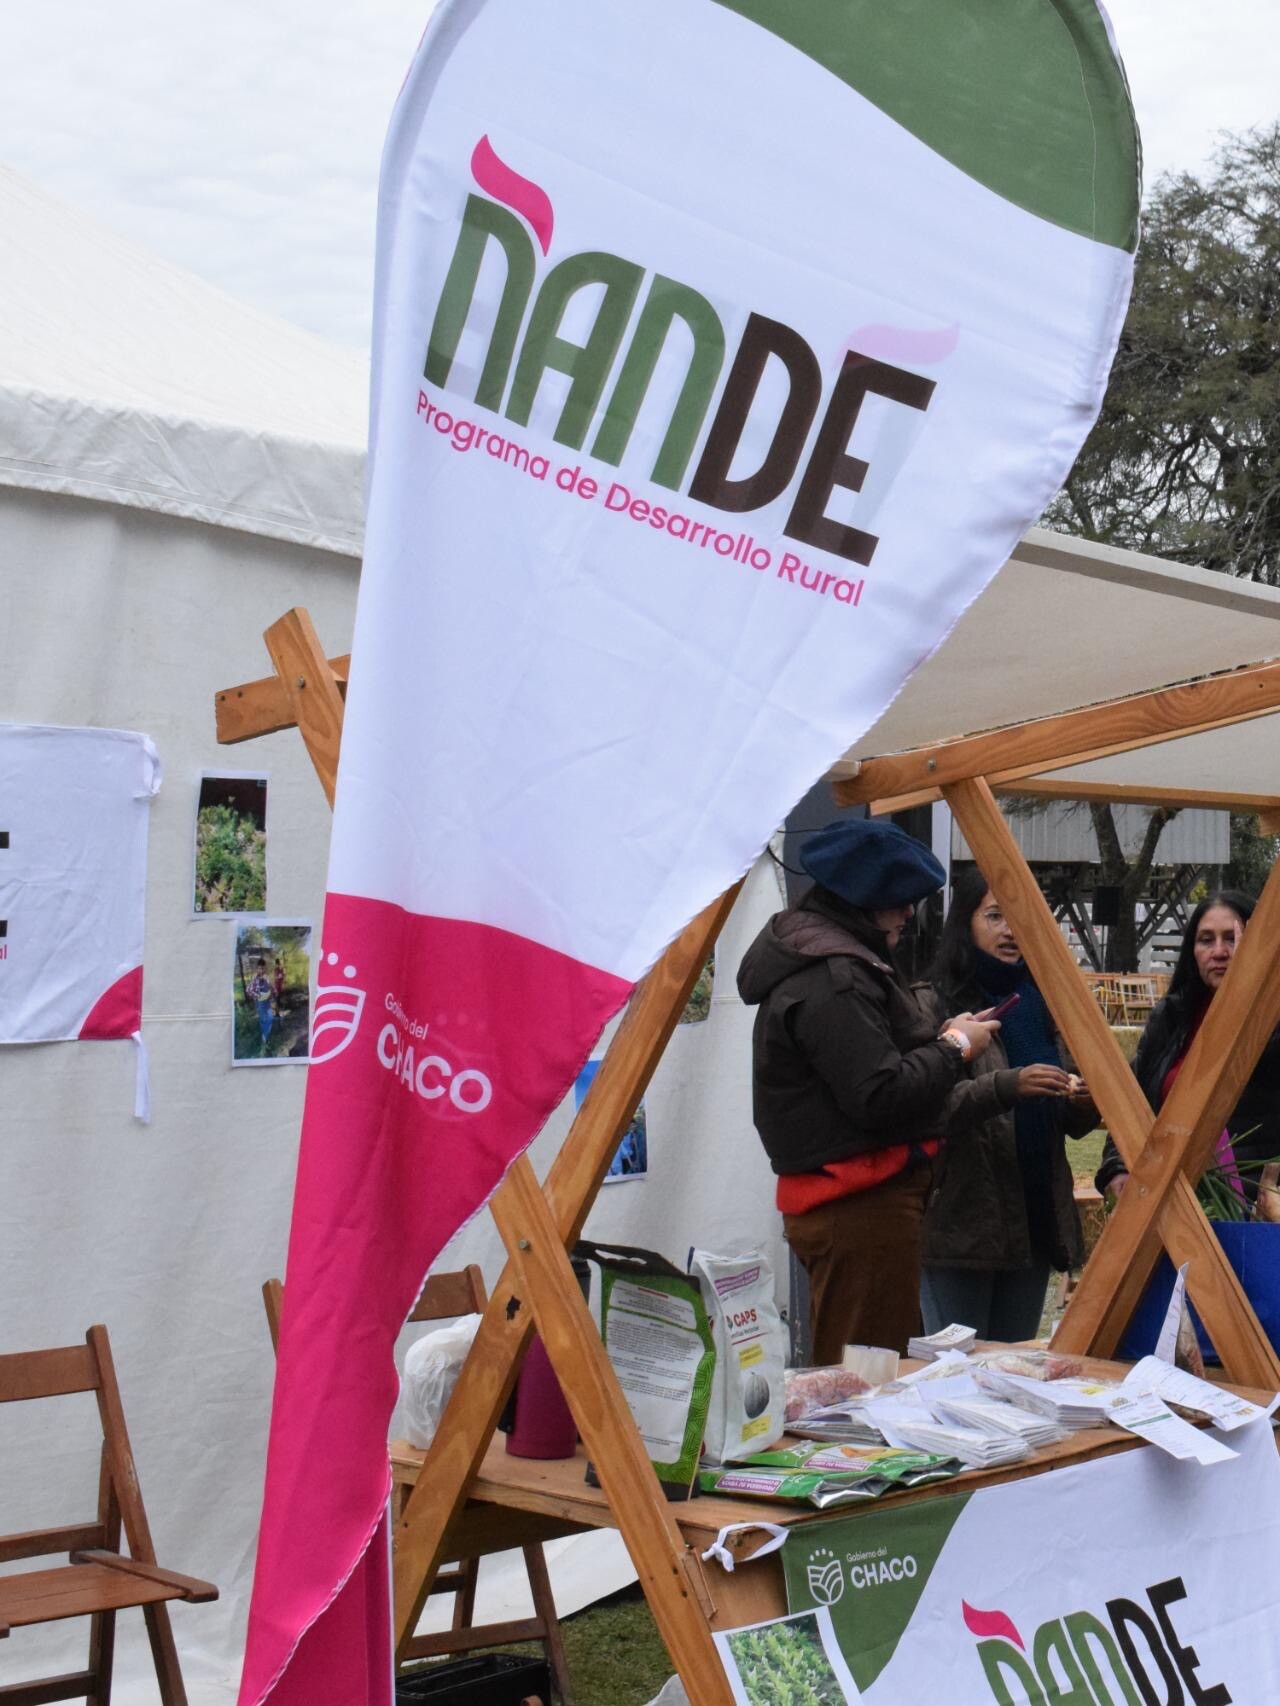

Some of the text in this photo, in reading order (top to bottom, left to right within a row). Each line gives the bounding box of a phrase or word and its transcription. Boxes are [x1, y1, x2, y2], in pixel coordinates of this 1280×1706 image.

[417, 390, 864, 607] Programa de Desarrollo Rural
[409, 1019, 429, 1040] del
[733, 1308, 758, 1328] CAPS
[846, 1546, 888, 1562] Gobierno del
[850, 1555, 917, 1589] CHACO
